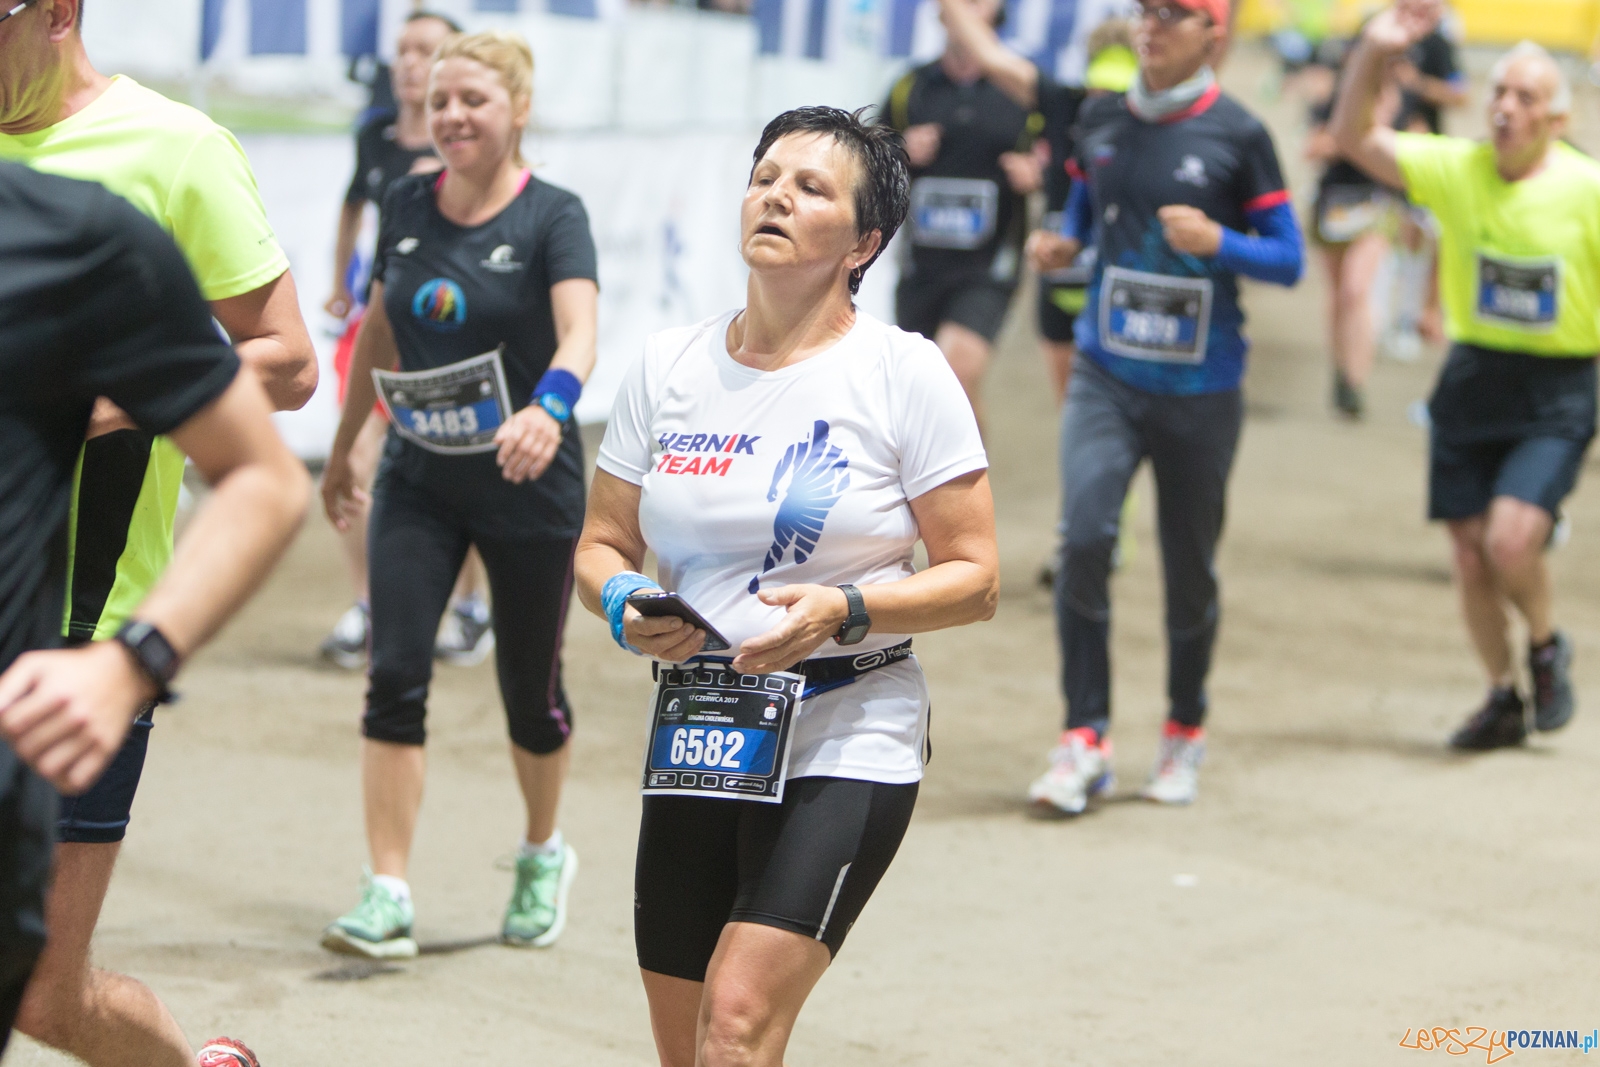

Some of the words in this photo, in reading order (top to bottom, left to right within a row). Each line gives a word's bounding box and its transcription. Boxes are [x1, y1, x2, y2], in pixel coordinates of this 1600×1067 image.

[410, 406, 479, 438] 3483
[658, 432, 762, 455] HERNIK
[657, 454, 734, 476] TEAM
[688, 694, 695, 702] 17
[695, 695, 723, 703] CZERWCA
[723, 696, 739, 704] 2017
[670, 727, 745, 769] 6582
